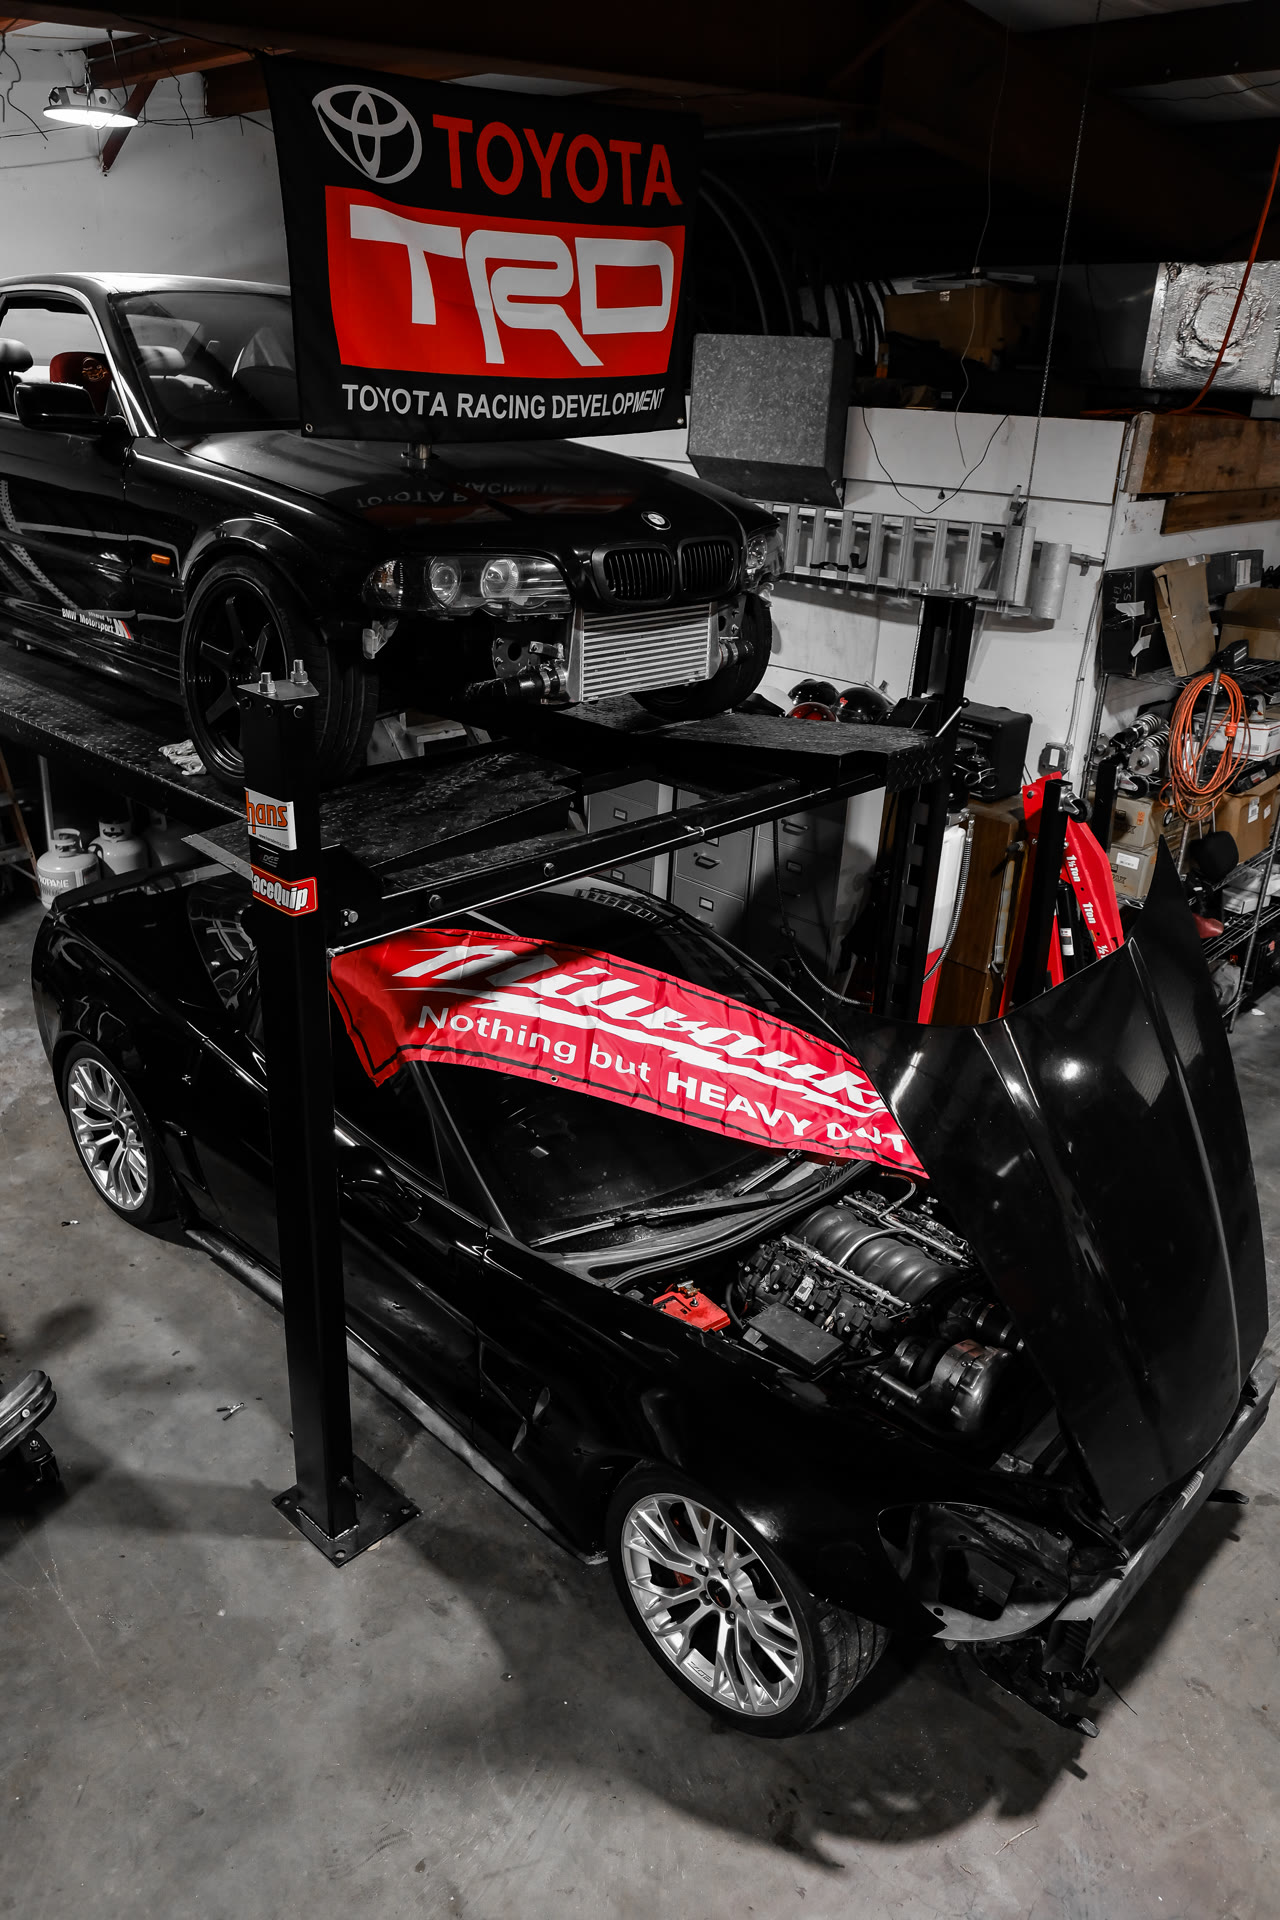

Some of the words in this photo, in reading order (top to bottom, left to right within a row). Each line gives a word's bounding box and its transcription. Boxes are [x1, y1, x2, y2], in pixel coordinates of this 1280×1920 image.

[432, 113, 684, 207] TOYOTA
[349, 203, 675, 367] TRD
[341, 383, 449, 418] TOYOTA
[456, 392, 546, 420] RACING
[551, 387, 666, 420] DEVELOPMENT
[61, 607, 77, 621] BMW
[79, 613, 114, 633] Motorsport
[245, 790, 288, 834] hans
[417, 1005, 577, 1065] Nothing
[590, 1041, 652, 1084] but
[666, 1071, 813, 1137] HEAVY
